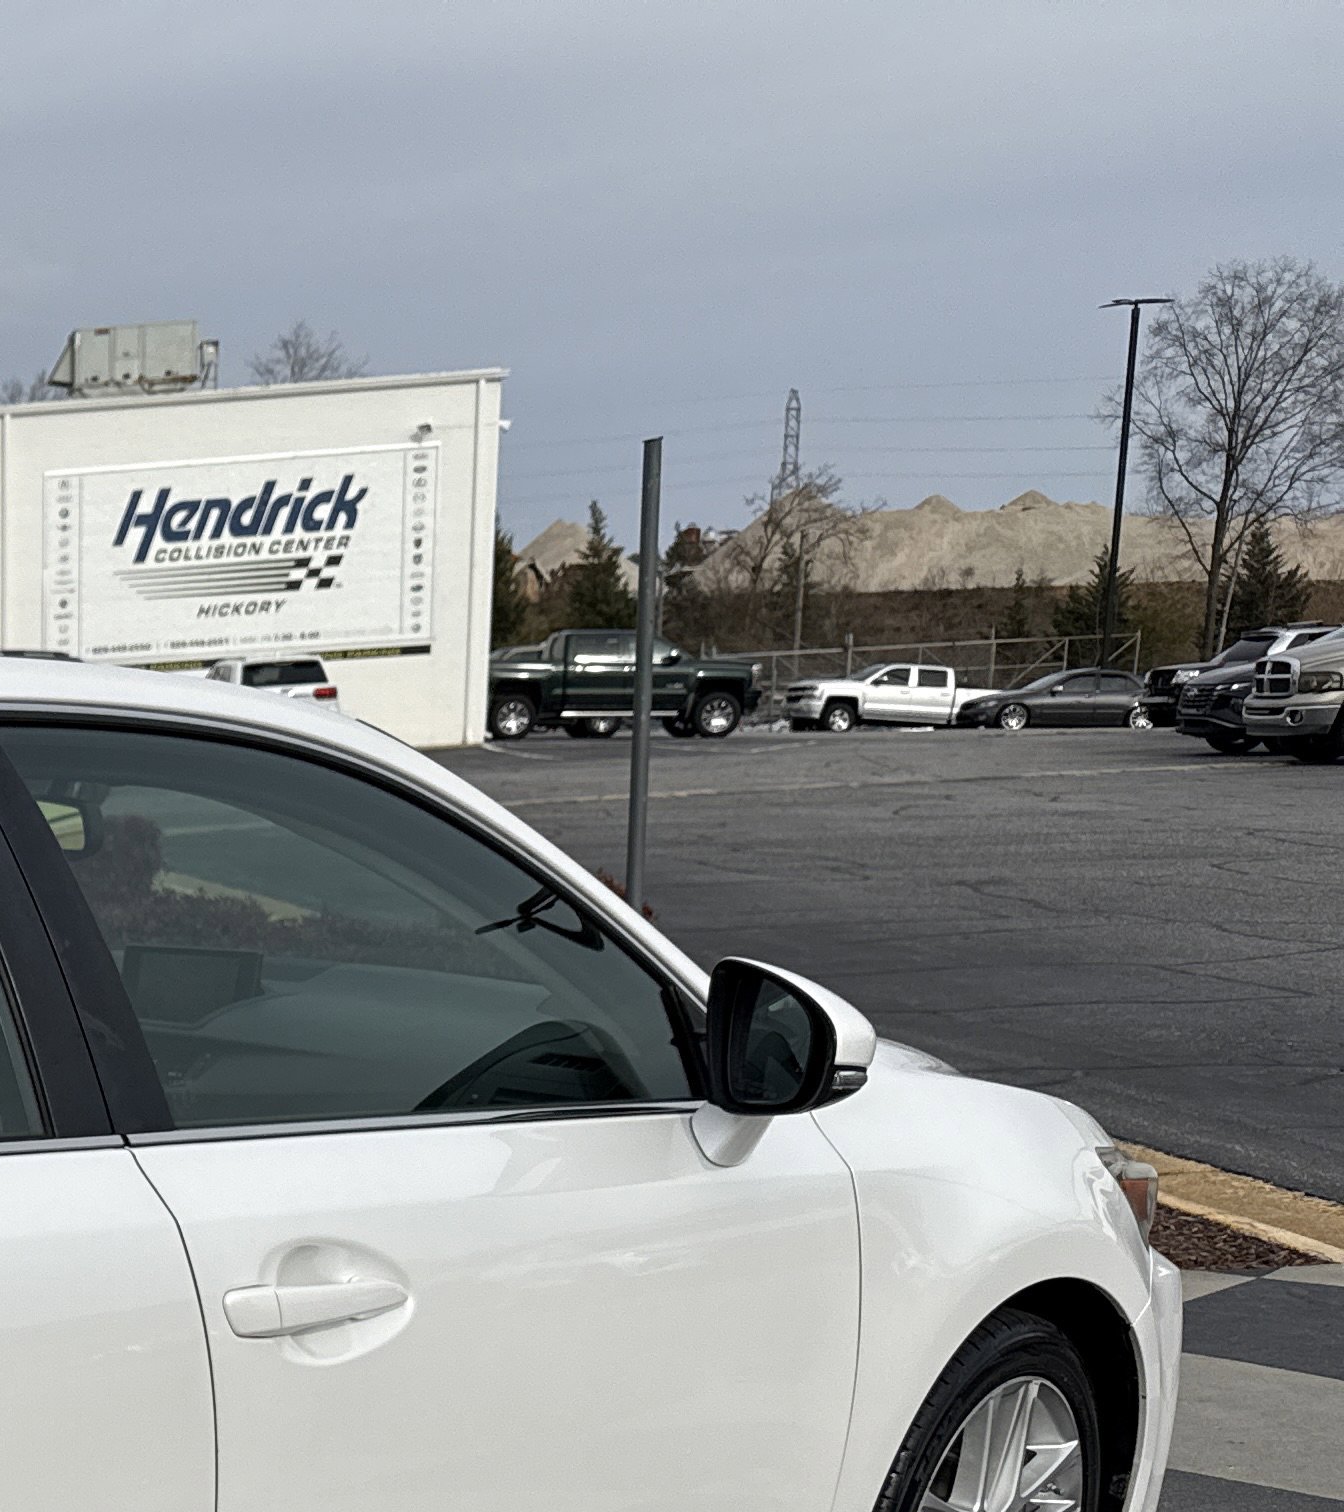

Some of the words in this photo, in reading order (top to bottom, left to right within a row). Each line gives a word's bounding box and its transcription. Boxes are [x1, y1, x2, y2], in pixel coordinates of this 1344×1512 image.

[113, 474, 368, 563] Hendrick
[155, 543, 262, 563] COLLISION
[268, 535, 351, 555] CENTER
[197, 599, 286, 618] HICKORY
